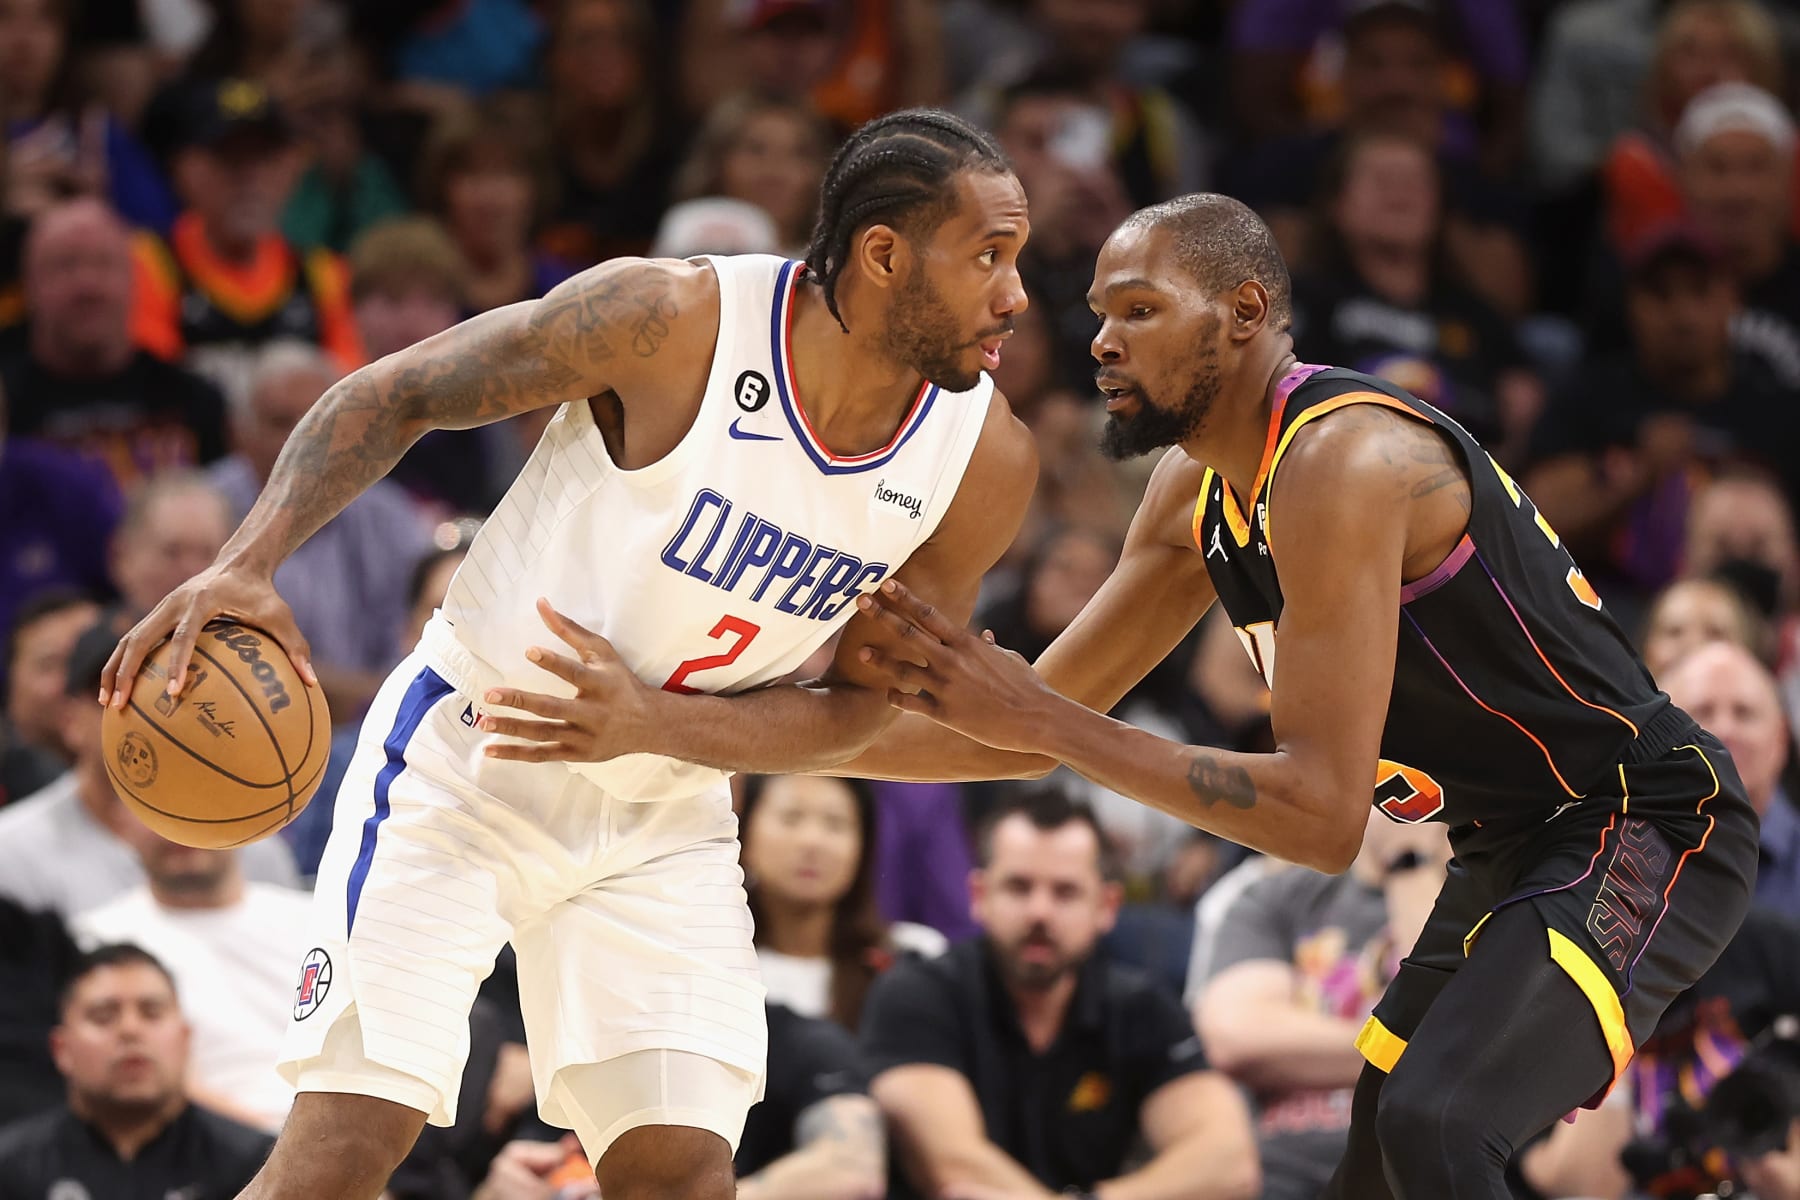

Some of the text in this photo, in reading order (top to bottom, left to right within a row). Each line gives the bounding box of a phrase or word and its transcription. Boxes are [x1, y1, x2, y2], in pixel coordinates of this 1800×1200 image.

[739, 375, 763, 409] 6
[874, 478, 922, 519] honey
[661, 487, 889, 622] CLIPPERS
[660, 613, 761, 696] 2
